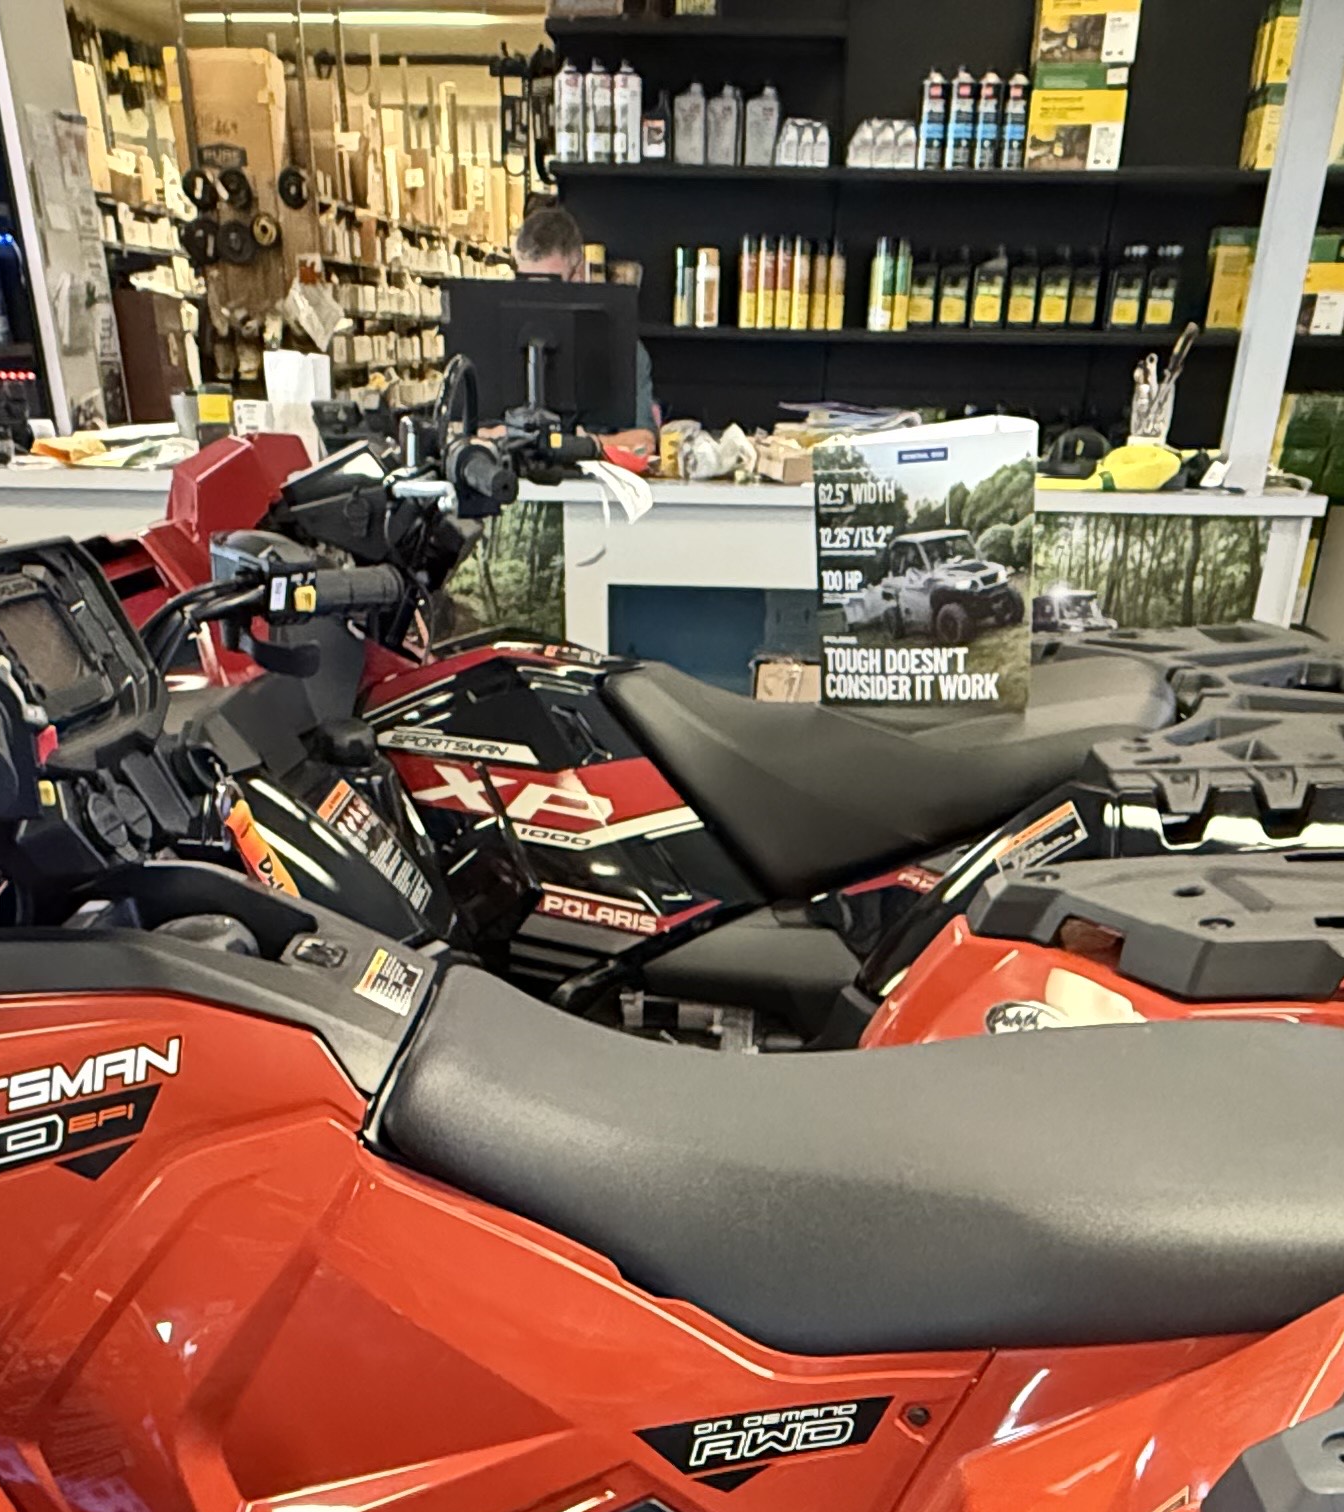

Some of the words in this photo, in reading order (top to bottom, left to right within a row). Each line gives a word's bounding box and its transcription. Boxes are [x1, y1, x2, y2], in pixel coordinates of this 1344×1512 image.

[818, 481, 850, 505] 62.5"
[851, 480, 896, 505] WIDTH
[822, 570, 844, 592] 100
[844, 570, 864, 592] HP
[824, 647, 881, 674] TOUGH
[885, 646, 969, 674] DOESN'T
[825, 674, 911, 700] CONSIDER
[915, 674, 935, 700] IT
[938, 672, 1000, 700] WORK
[388, 733, 509, 757] SPORTSMAN
[412, 763, 614, 828] XP
[520, 827, 592, 847] 1000
[544, 894, 657, 934] POLARIS
[67, 1101, 135, 1135] EFI
[693, 1419, 733, 1436] ON
[742, 1403, 858, 1429] DEMAND
[688, 1416, 855, 1467] AWD
